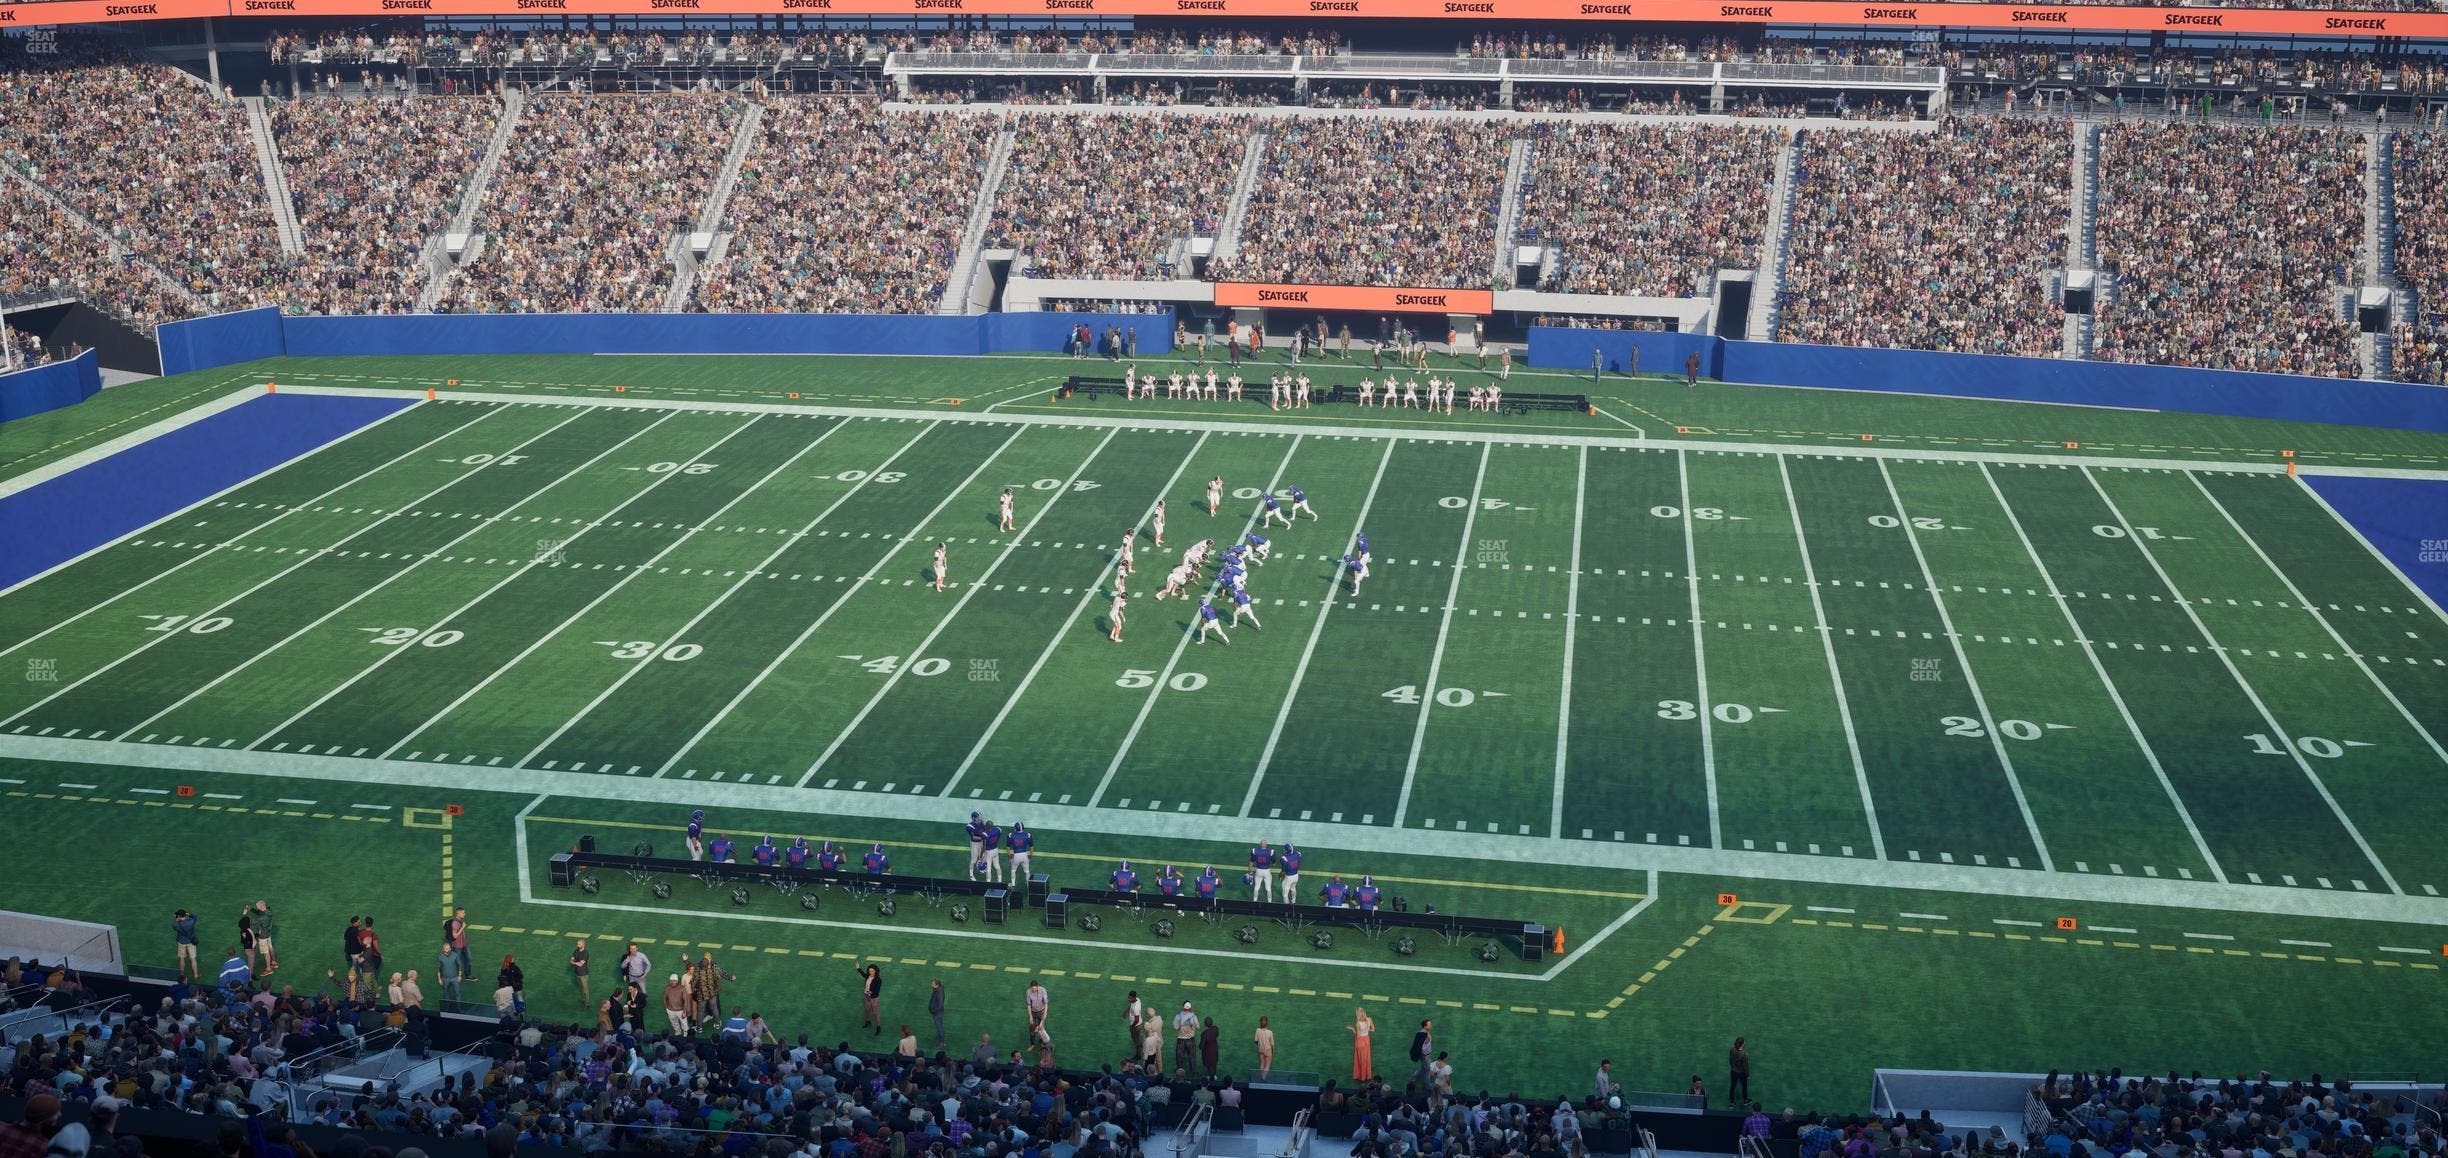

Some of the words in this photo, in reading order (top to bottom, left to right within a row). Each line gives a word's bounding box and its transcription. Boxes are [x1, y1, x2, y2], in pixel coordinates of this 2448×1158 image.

[106, 4, 157, 16] SEATGEEK
[246, 0, 295, 10] SEATGEEK
[382, 0, 432, 9] SEATGEEK
[518, 0, 567, 9] SEATGEEK
[651, 0, 700, 8] SEATGEEK
[784, 0, 831, 8] SEATGEEK
[915, 0, 963, 8] SEATGEEK
[1046, 0, 1093, 9] SEATGEEK
[1178, 0, 1225, 10] SEATGEEK
[1310, 1, 1358, 11] SEATGEEK
[1445, 3, 1493, 13] SEATGEEK
[1581, 4, 1631, 14] SEATGEEK
[1721, 6, 1772, 17] SEATGEEK
[1864, 8, 1916, 20] SEATGEEK
[2012, 11, 2067, 22] SEATGEEK
[2165, 14, 2222, 26] SEATGEEK
[2326, 18, 2386, 30] SEATGEEK
[1258, 290, 1308, 302] SEATGEEK
[1396, 294, 1446, 306] SEATGEEK
[461, 453, 529, 465] 10
[646, 462, 719, 474] 20
[836, 470, 907, 483] 30
[1031, 478, 1102, 492] 40
[1438, 496, 1510, 510] 40
[1650, 505, 1724, 520] 30
[1868, 515, 1945, 530] 20
[2092, 525, 2166, 540] 10
[145, 615, 234, 634] 10
[369, 627, 464, 648] 20
[610, 641, 703, 661] 30
[861, 655, 951, 676] 40
[1115, 669, 1208, 692] 50
[1381, 685, 1475, 707] 40
[1657, 700, 1753, 723] 30
[1940, 716, 2042, 741] 20
[2243, 734, 2343, 758] 10
[1723, 895, 1732, 904] 30
[2062, 919, 2072, 928] 20
